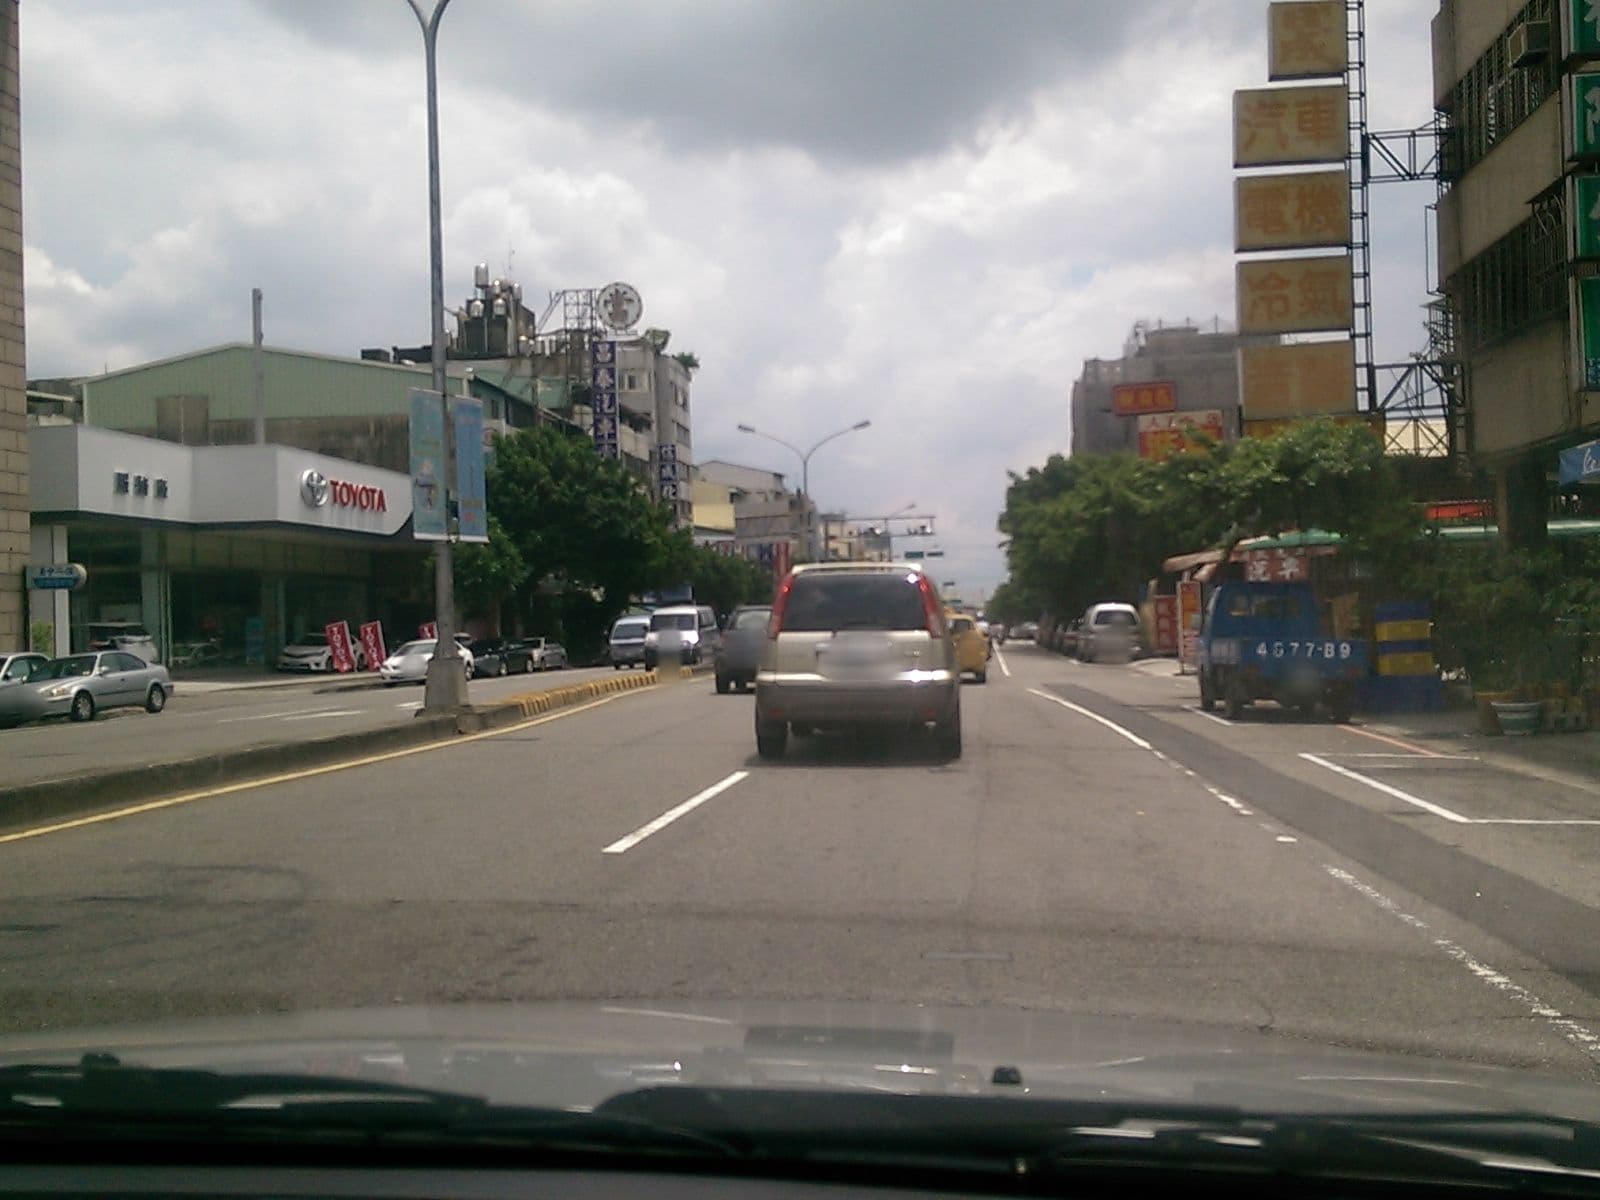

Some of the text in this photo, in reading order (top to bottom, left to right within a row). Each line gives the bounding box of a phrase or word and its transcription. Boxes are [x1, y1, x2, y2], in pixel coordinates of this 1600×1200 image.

[1239, 96, 1338, 152] 汽車
[1244, 269, 1346, 323] 冷氣
[329, 479, 386, 512] TOYOTA
[331, 626, 349, 671] TOYOTA
